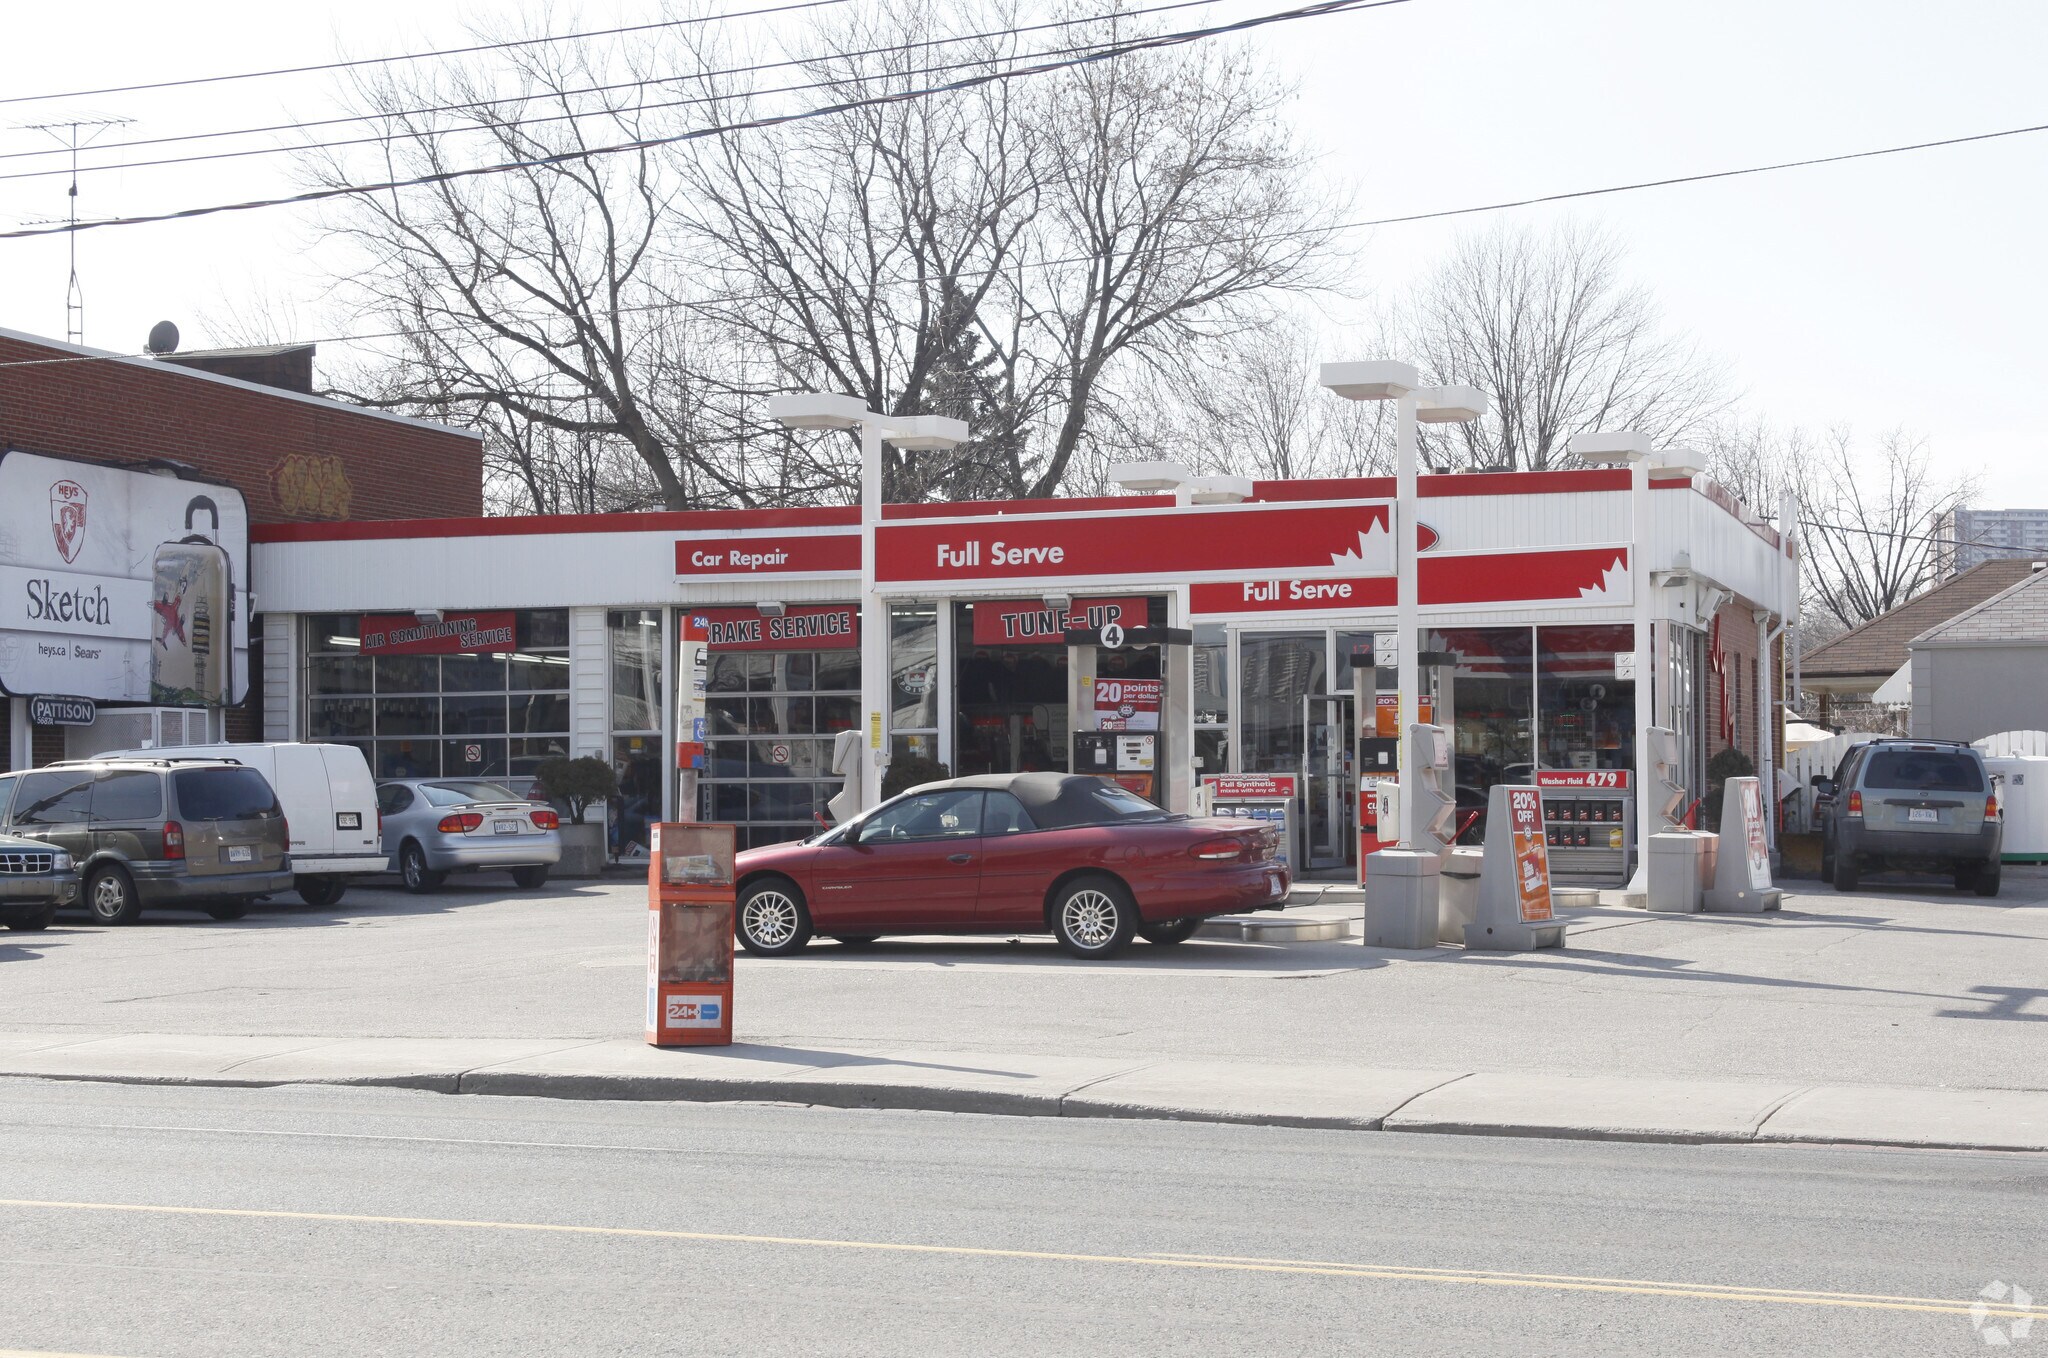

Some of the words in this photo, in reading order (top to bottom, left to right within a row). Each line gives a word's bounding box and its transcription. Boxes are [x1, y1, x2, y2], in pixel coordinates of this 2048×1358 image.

[691, 551, 723, 567] Car
[729, 548, 789, 570] Repair
[937, 541, 980, 567] Full
[991, 541, 1065, 566] Serve
[1243, 580, 1280, 602] Full
[1289, 580, 1352, 600] Serve
[26, 579, 110, 625] Sketch
[770, 612, 851, 640] SERVICE
[1001, 605, 1121, 638] TUNE-UP
[365, 632, 385, 648] AIR
[390, 618, 477, 644] CONDITIONING
[460, 627, 512, 648] SERVICE
[1105, 626, 1120, 646] 4
[38, 643, 66, 657] heys.ca
[1096, 682, 1121, 702] 20
[1123, 683, 1159, 693] points
[37, 702, 91, 719] PATTISON
[1102, 721, 1113, 729] 20
[1567, 777, 1583, 785] Fluid
[1587, 773, 1617, 787] 479
[1513, 792, 1536, 809] 20%
[1517, 810, 1535, 823] OFF!
